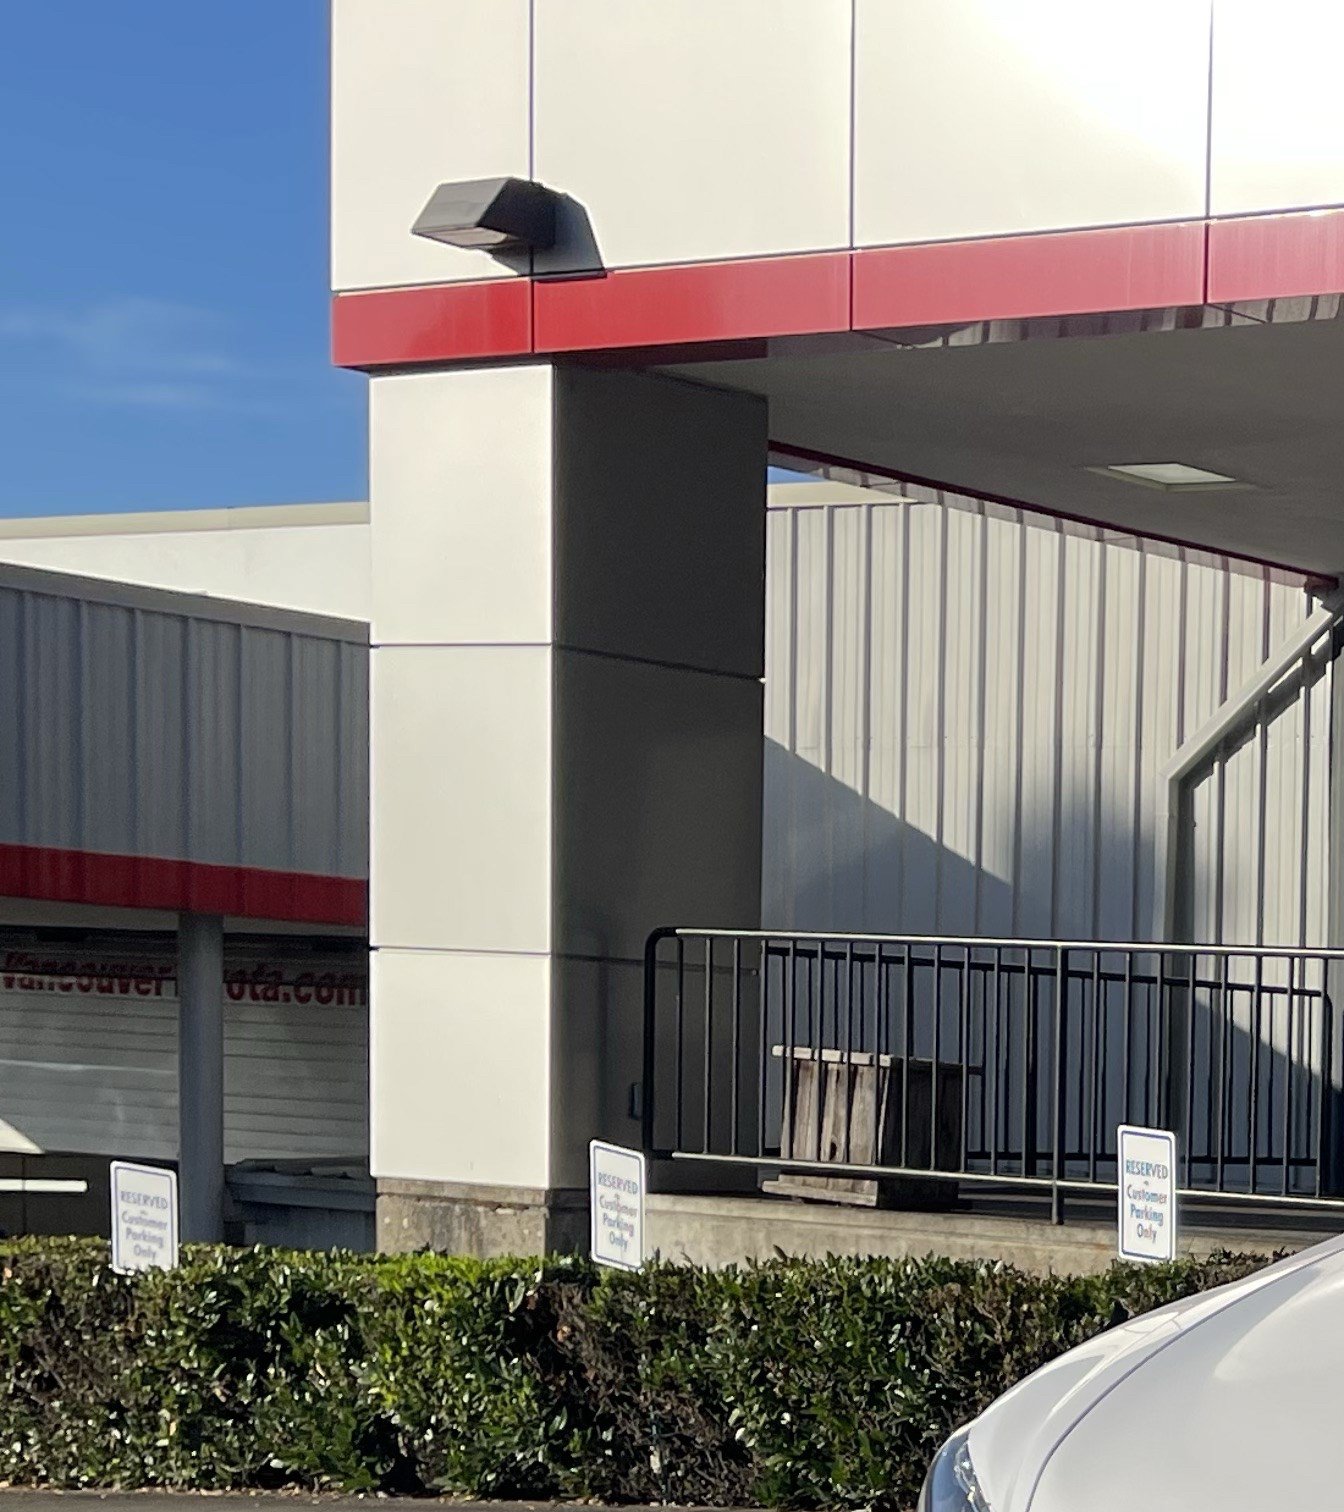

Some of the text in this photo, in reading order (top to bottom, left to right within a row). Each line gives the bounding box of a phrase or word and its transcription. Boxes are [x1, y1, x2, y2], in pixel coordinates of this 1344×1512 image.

[1126, 1159, 1168, 1180] RESERVED
[598, 1172, 638, 1195] RESERVED
[1127, 1184, 1167, 1204] Customer
[120, 1191, 167, 1209] RESERVED
[599, 1195, 637, 1216] Customer
[122, 1211, 167, 1230] Customer
[603, 1212, 634, 1237] Parking
[1130, 1203, 1163, 1226] Parking
[126, 1228, 163, 1249] Parking
[609, 1231, 628, 1252] Only
[1137, 1223, 1157, 1243] Only
[134, 1244, 156, 1261] Only
